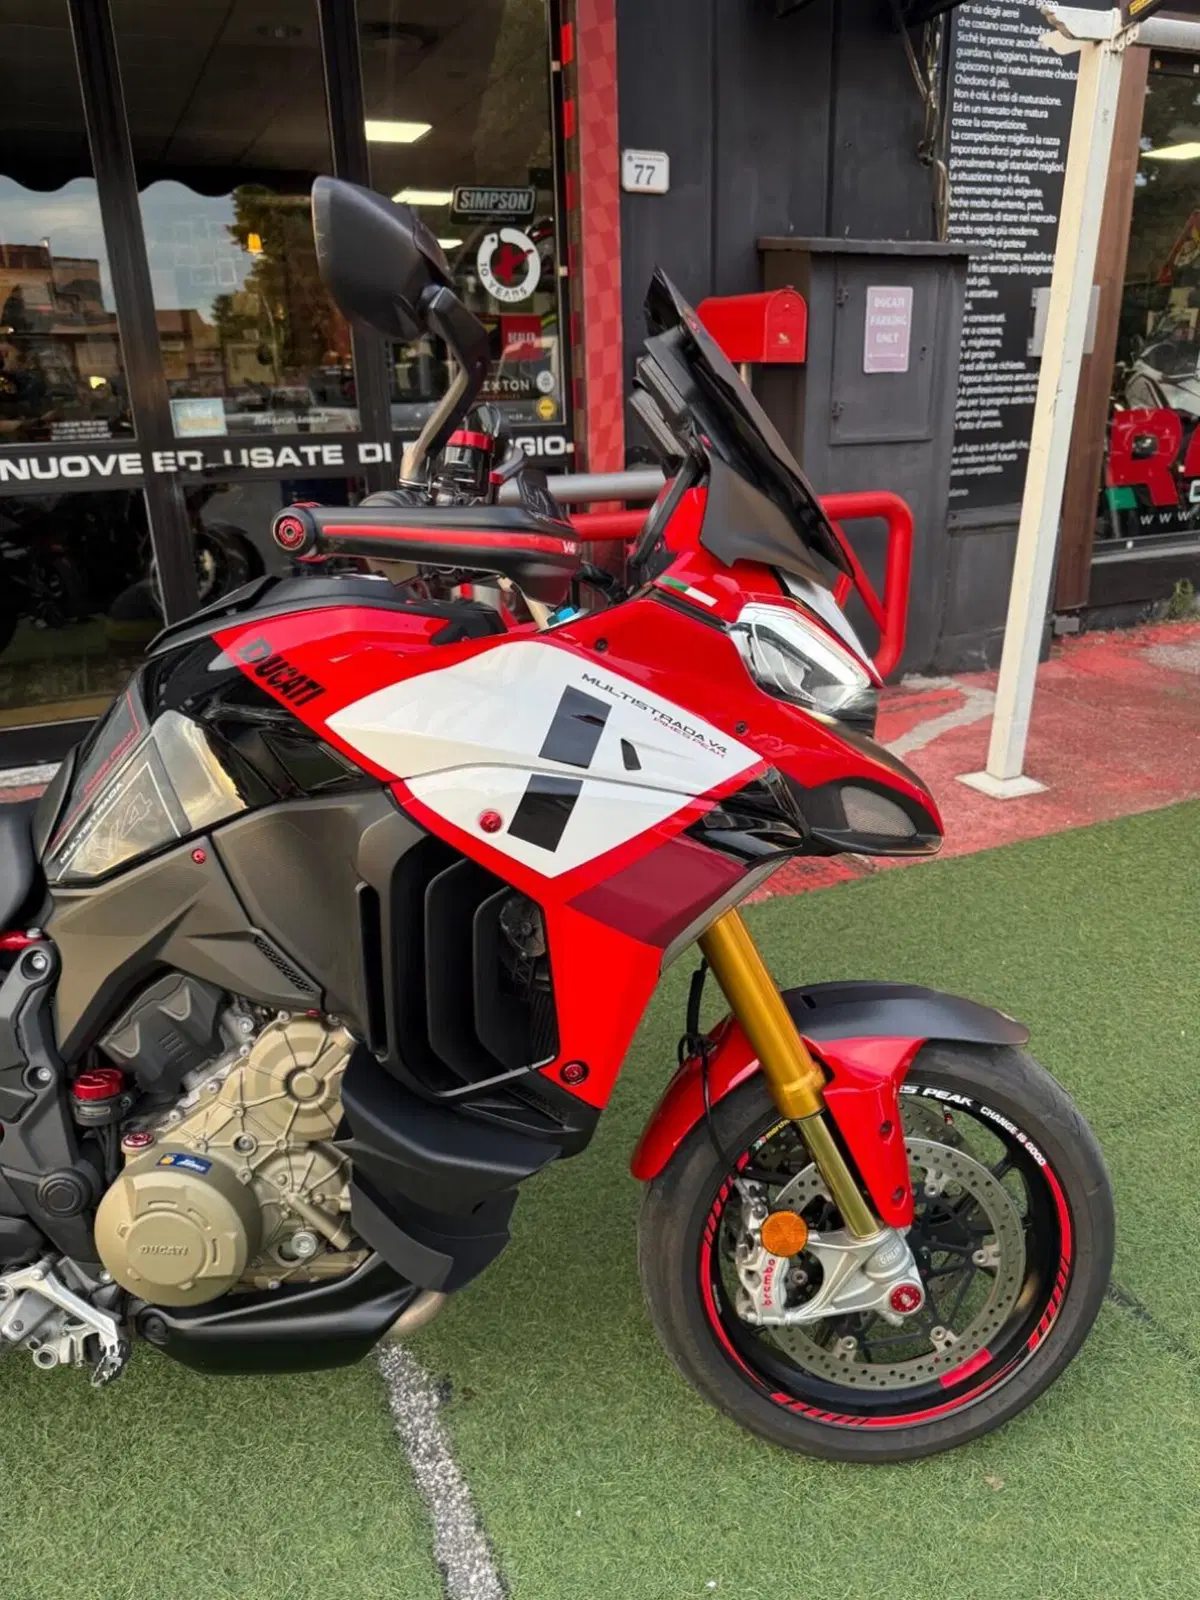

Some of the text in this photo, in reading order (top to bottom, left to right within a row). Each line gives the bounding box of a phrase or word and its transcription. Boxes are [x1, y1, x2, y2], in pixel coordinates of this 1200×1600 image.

[959, 4, 1019, 18] Per via degli aerei
[958, 17, 970, 27] che
[972, 19, 999, 30] costano
[1000, 23, 1019, 32] come
[957, 32, 978, 42] Sicché
[980, 34, 986, 43] le
[987, 36, 1015, 46] persone
[956, 48, 1063, 66] guardano, viaggiano, imparano,
[955, 61, 989, 72] capiscono
[996, 64, 1007, 76] poi
[1009, 67, 1053, 79] naturalmente
[1054, 69, 1078, 81] chiedo
[955, 74, 1010, 89] Chiedono di più.
[954, 88, 969, 98] Non
[976, 90, 990, 101] crisi,
[997, 92, 1009, 102] crisi
[1011, 92, 1018, 102] di
[1019, 95, 1062, 106] maturazione.
[953, 102, 1049, 118] Ed in un mercato che matura
[952, 117, 1028, 131] cresce la competizione.
[951, 130, 1060, 146] La competizione migliora la razza
[950, 143, 990, 156] imponendo
[991, 144, 1009, 156] sforzi
[1010, 148, 1021, 158] per
[949, 157, 995, 169] giornalmente
[996, 159, 1008, 172] agli
[1009, 160, 1039, 171] standard
[634, 164, 656, 185] 77
[949, 171, 957, 180] La
[958, 171, 992, 182] situazione
[993, 174, 1007, 182] non
[1013, 173, 1030, 185] dura,
[953, 185, 1001, 196] estremamente
[1002, 185, 1013, 198] più
[460, 191, 529, 210] SIMPSON
[970, 197, 990, 208] molto
[959, 210, 969, 221] chi
[970, 212, 994, 221] accetta
[995, 211, 1001, 221] di
[1002, 213, 1018, 222] stare
[1019, 213, 1029, 222] nel
[1030, 213, 1057, 223] mercato
[974, 225, 995, 237] regole
[996, 225, 1007, 237] più
[995, 251, 1021, 262] impresa,
[971, 263, 988, 273] frutti
[990, 265, 1008, 273] senza
[1009, 264, 1019, 275] più
[488, 281, 527, 299] YEARS
[971, 349, 996, 360] proprio
[0, 453, 144, 481] NUOVE
[358, 442, 392, 463] DI
[238, 636, 327, 707] DUCATI
[581, 673, 728, 754] MULTISTRADA V4
[922, 1087, 975, 1107] PEAK
[980, 1106, 1020, 1135] CHANGE
[1024, 1141, 1047, 1166] GOOD
[139, 1244, 190, 1256] DUCATI
[761, 1258, 776, 1308] brembo
